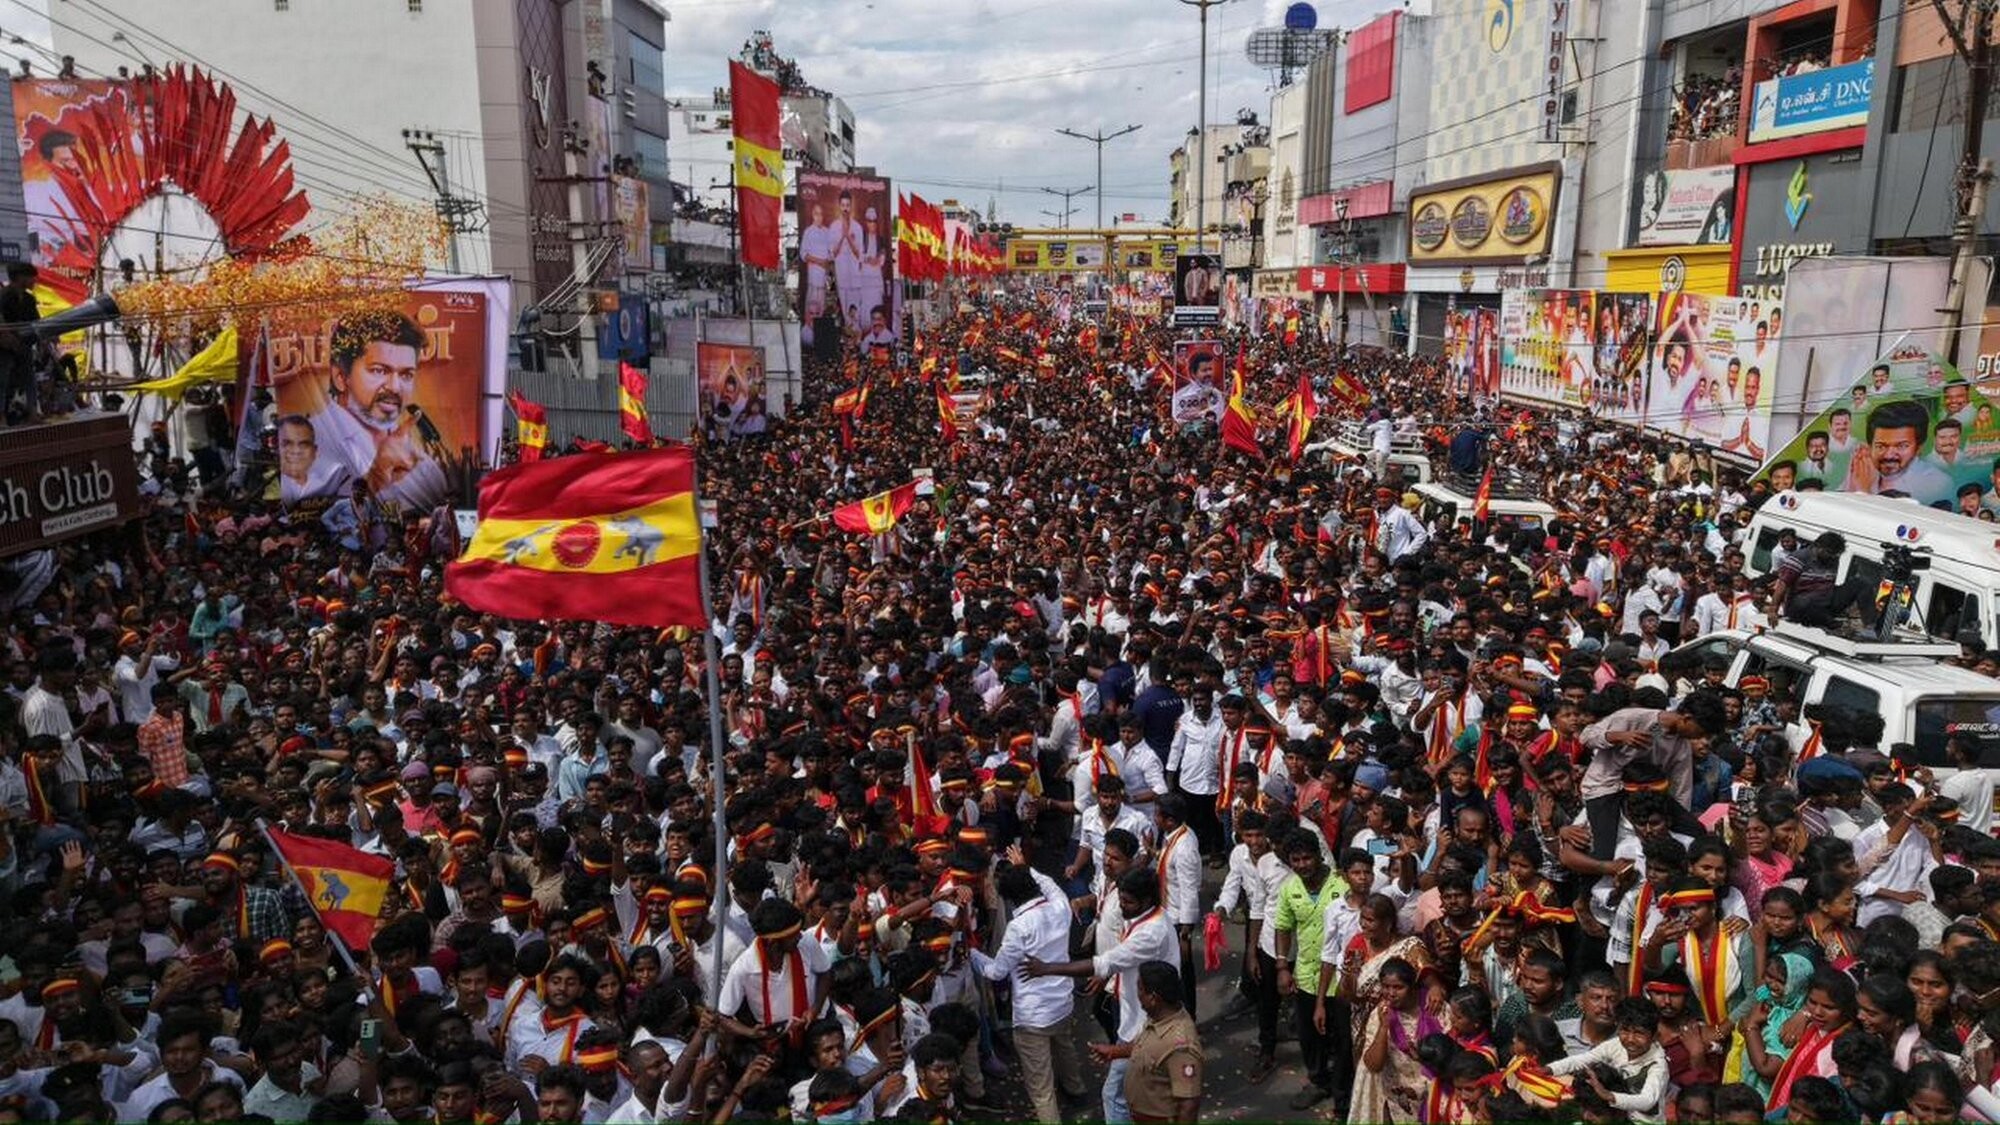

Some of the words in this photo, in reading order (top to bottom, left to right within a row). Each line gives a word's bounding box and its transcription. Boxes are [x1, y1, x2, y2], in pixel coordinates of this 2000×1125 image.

[1545, 31, 1563, 140] Hotel
[1742, 284, 1786, 301] FAS
[40, 461, 113, 511] Club
